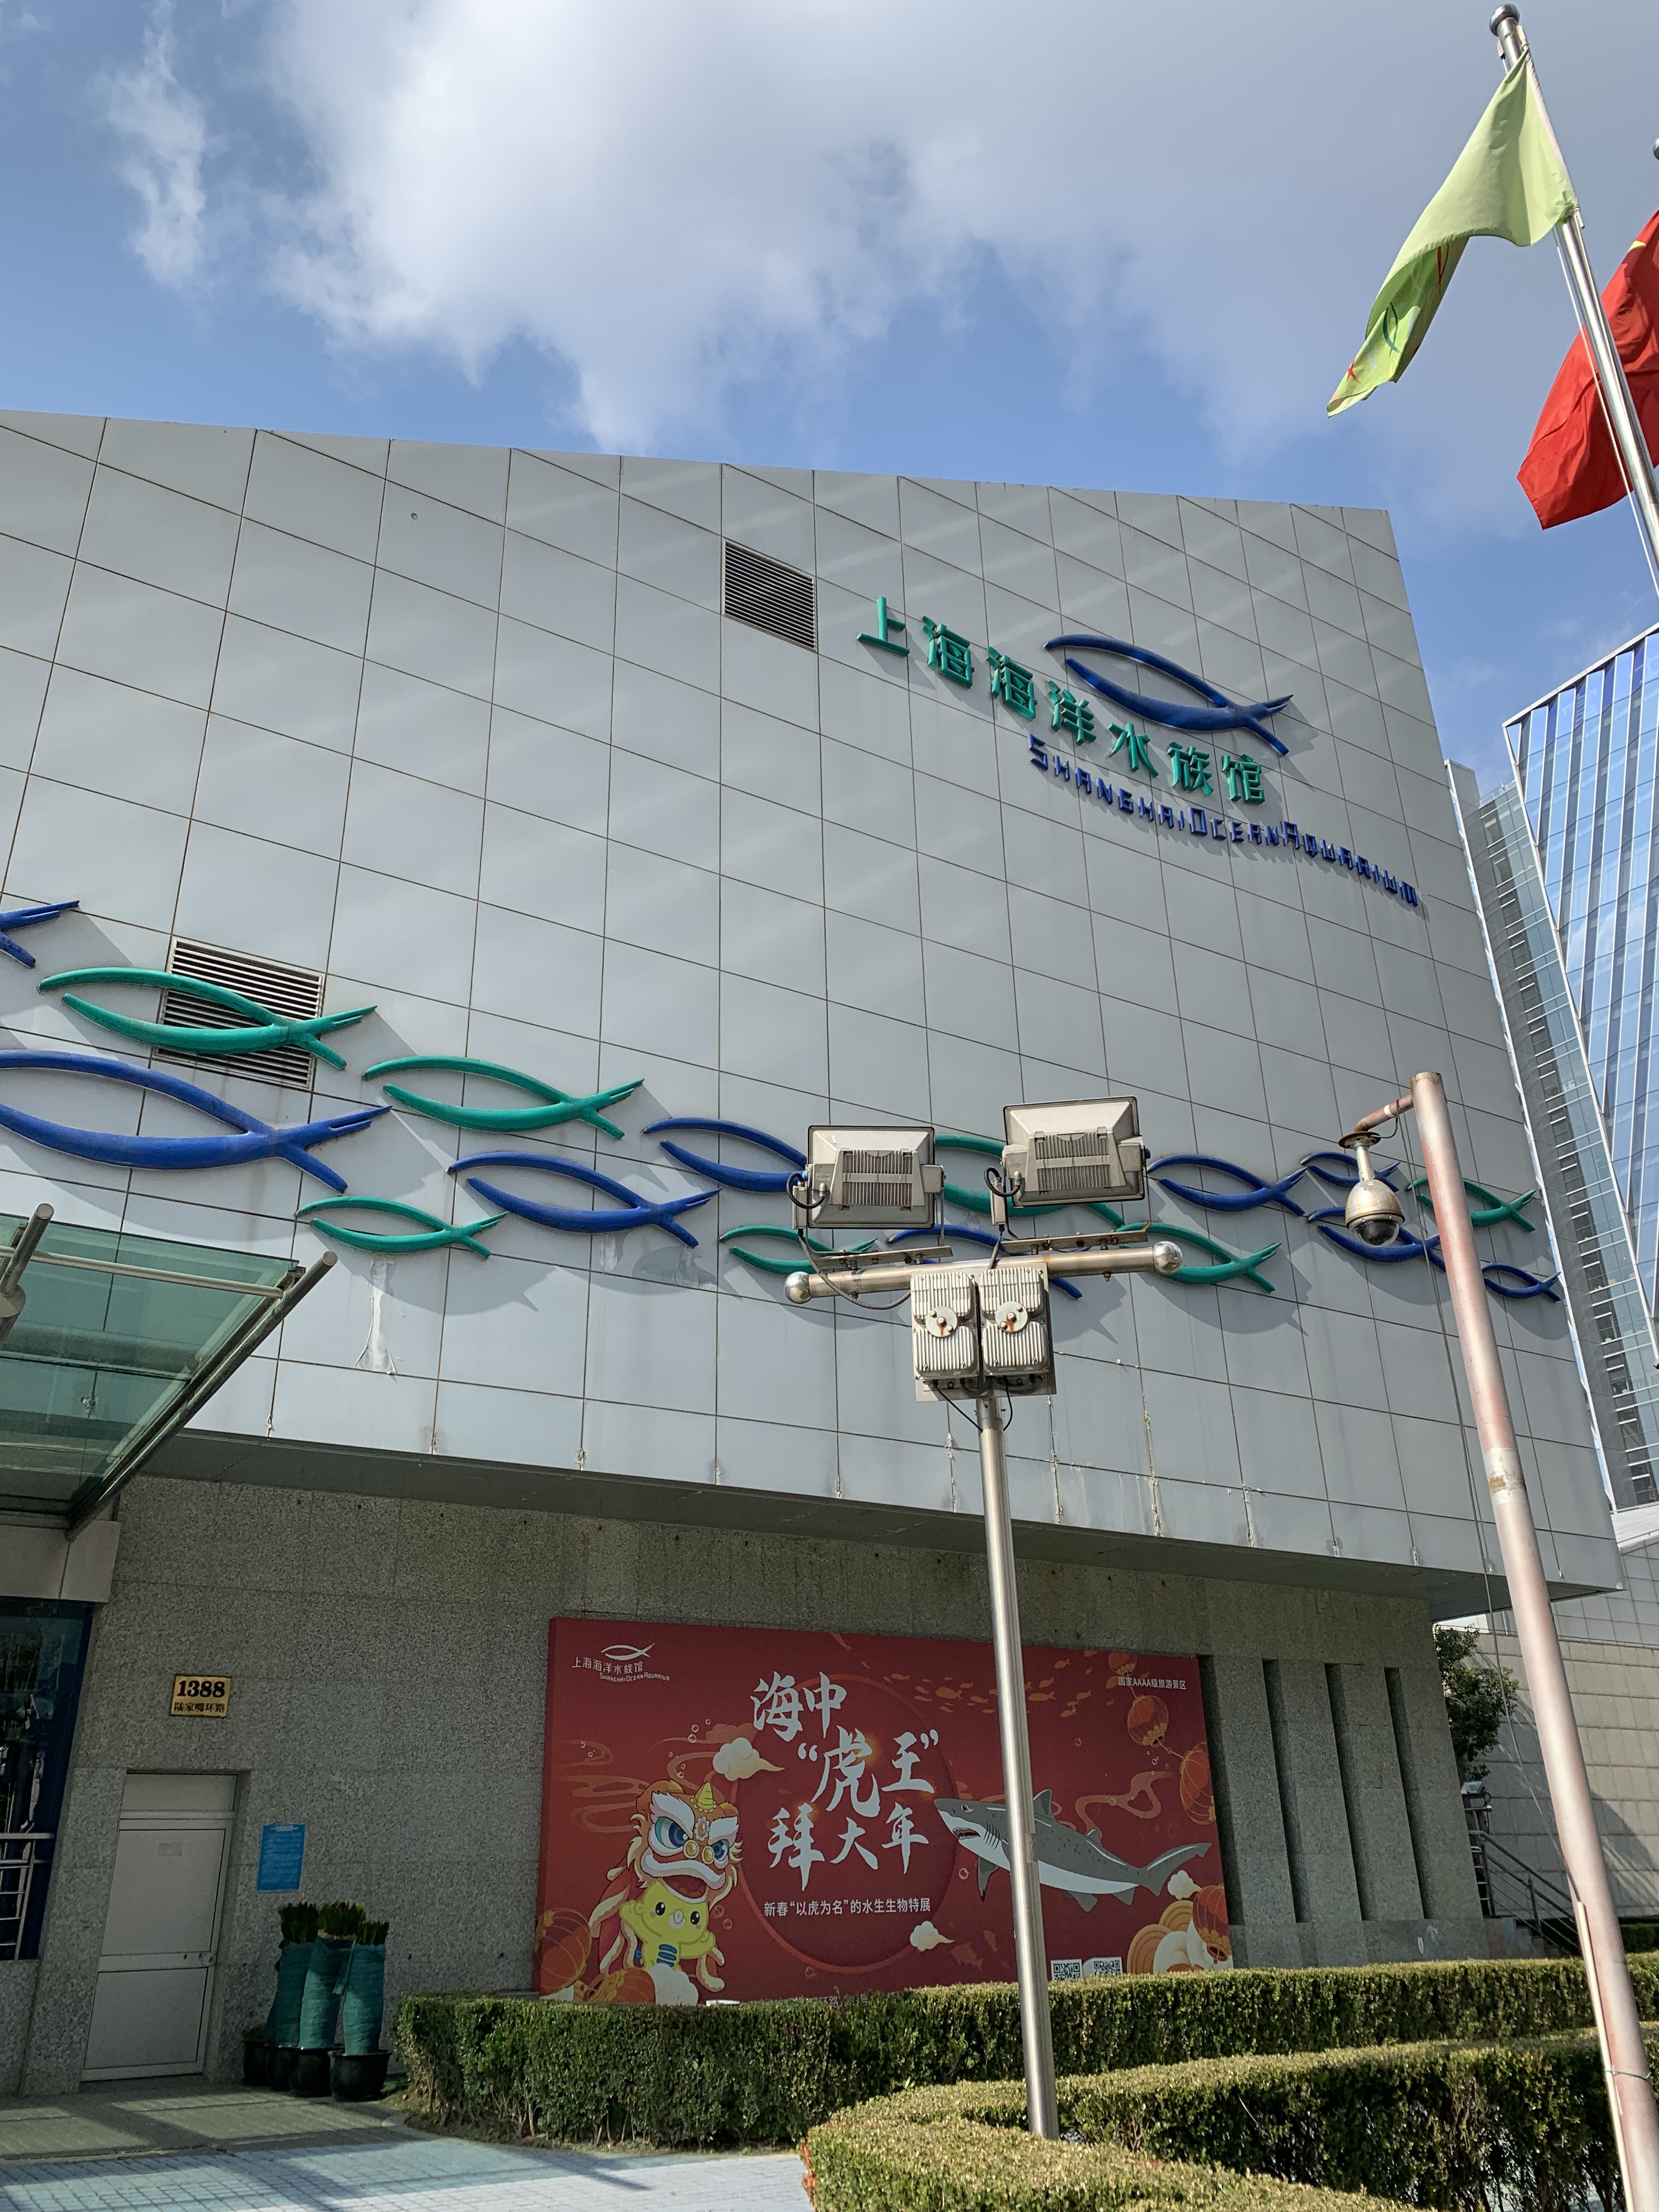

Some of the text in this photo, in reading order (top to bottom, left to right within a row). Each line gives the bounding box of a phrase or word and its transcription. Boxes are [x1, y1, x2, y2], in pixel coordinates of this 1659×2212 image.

[857, 596, 1265, 804] 上海海洋水族馆
[572, 1657, 644, 1674] 上海海洋水族馆
[1118, 1677, 1187, 1690] 国家AAAA级旅游景区
[177, 1680, 225, 1698] 1388
[750, 1672, 847, 1742] 海中
[768, 1802, 929, 1891] 拜大年
